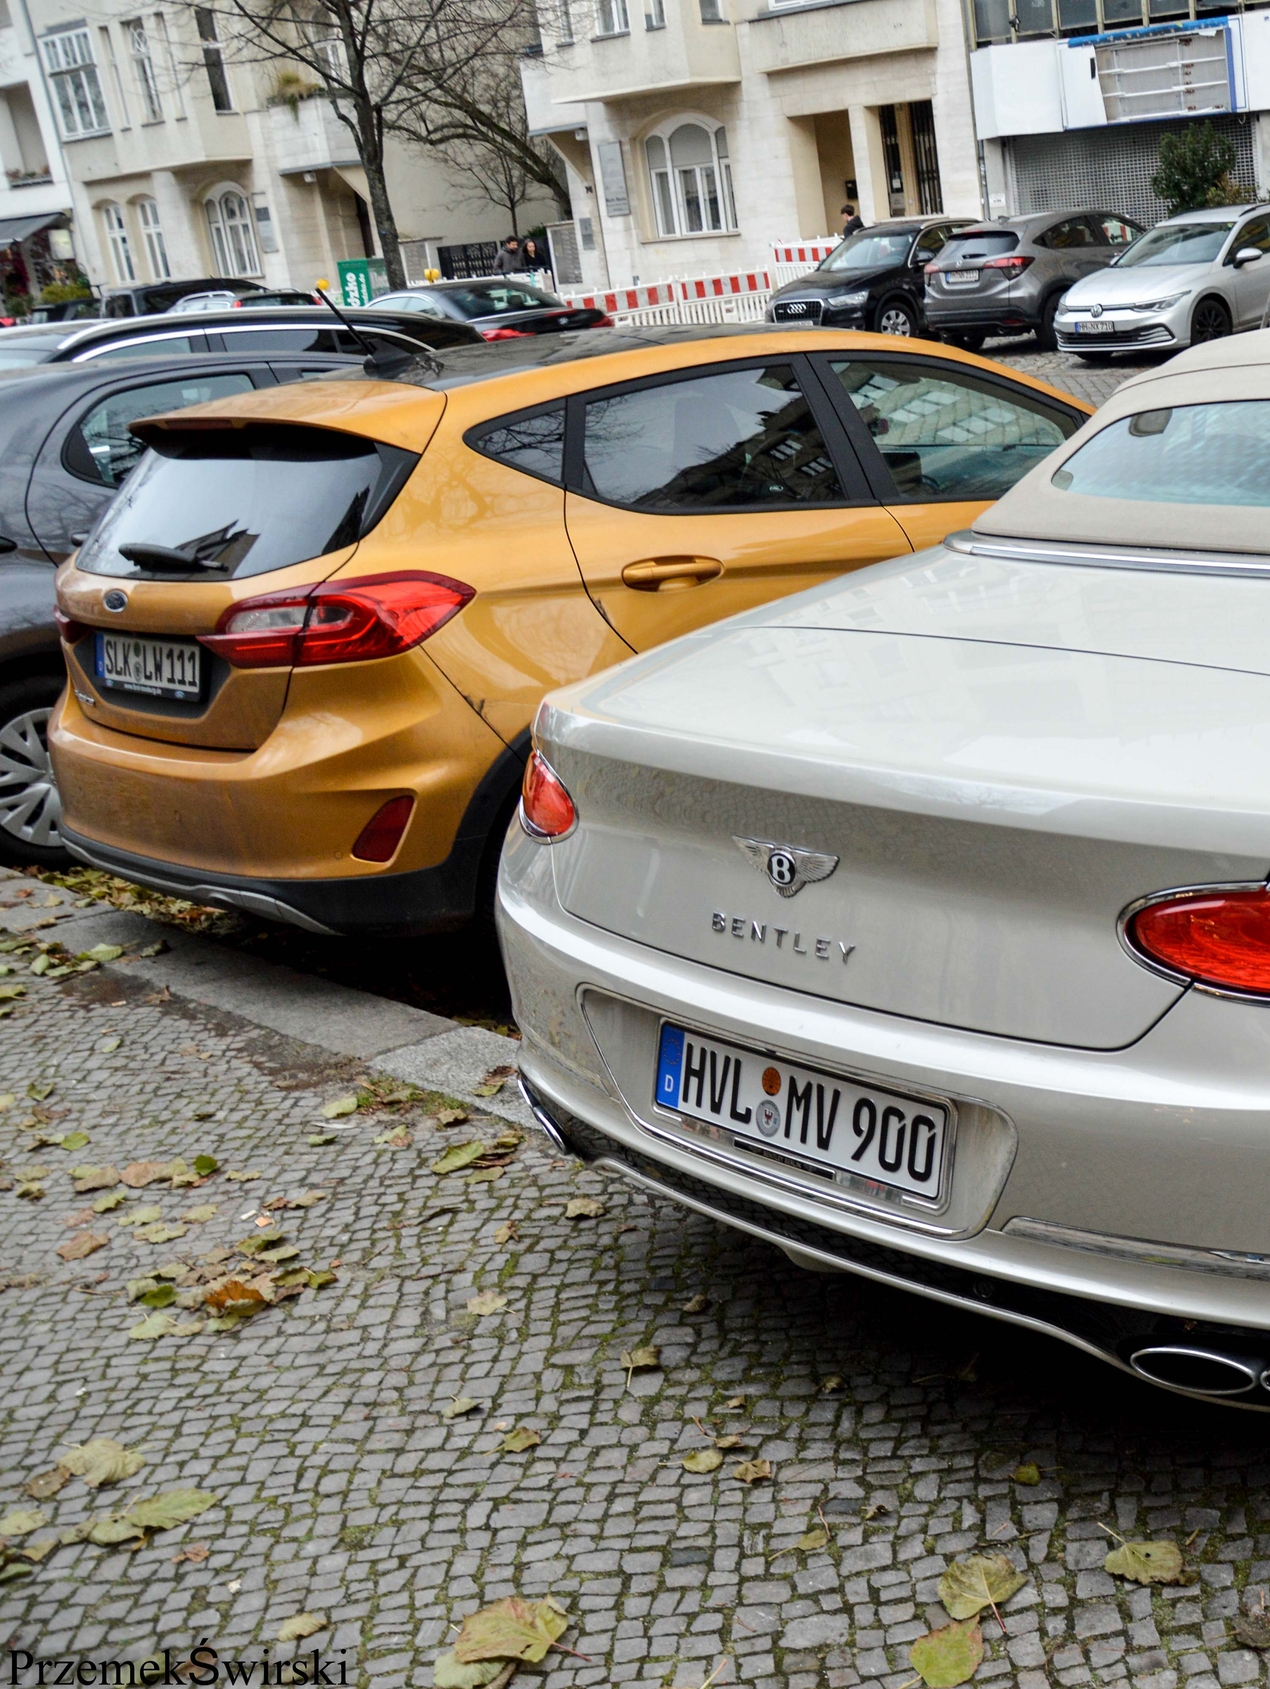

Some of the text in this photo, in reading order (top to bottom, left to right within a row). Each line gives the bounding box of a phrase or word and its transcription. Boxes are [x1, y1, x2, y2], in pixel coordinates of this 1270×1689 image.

[105, 640, 198, 687] SLK LW 111
[771, 856, 792, 884] B
[712, 911, 856, 964] BENTLEY
[664, 1074, 673, 1092] D
[682, 1042, 936, 1183] HVL MV 900
